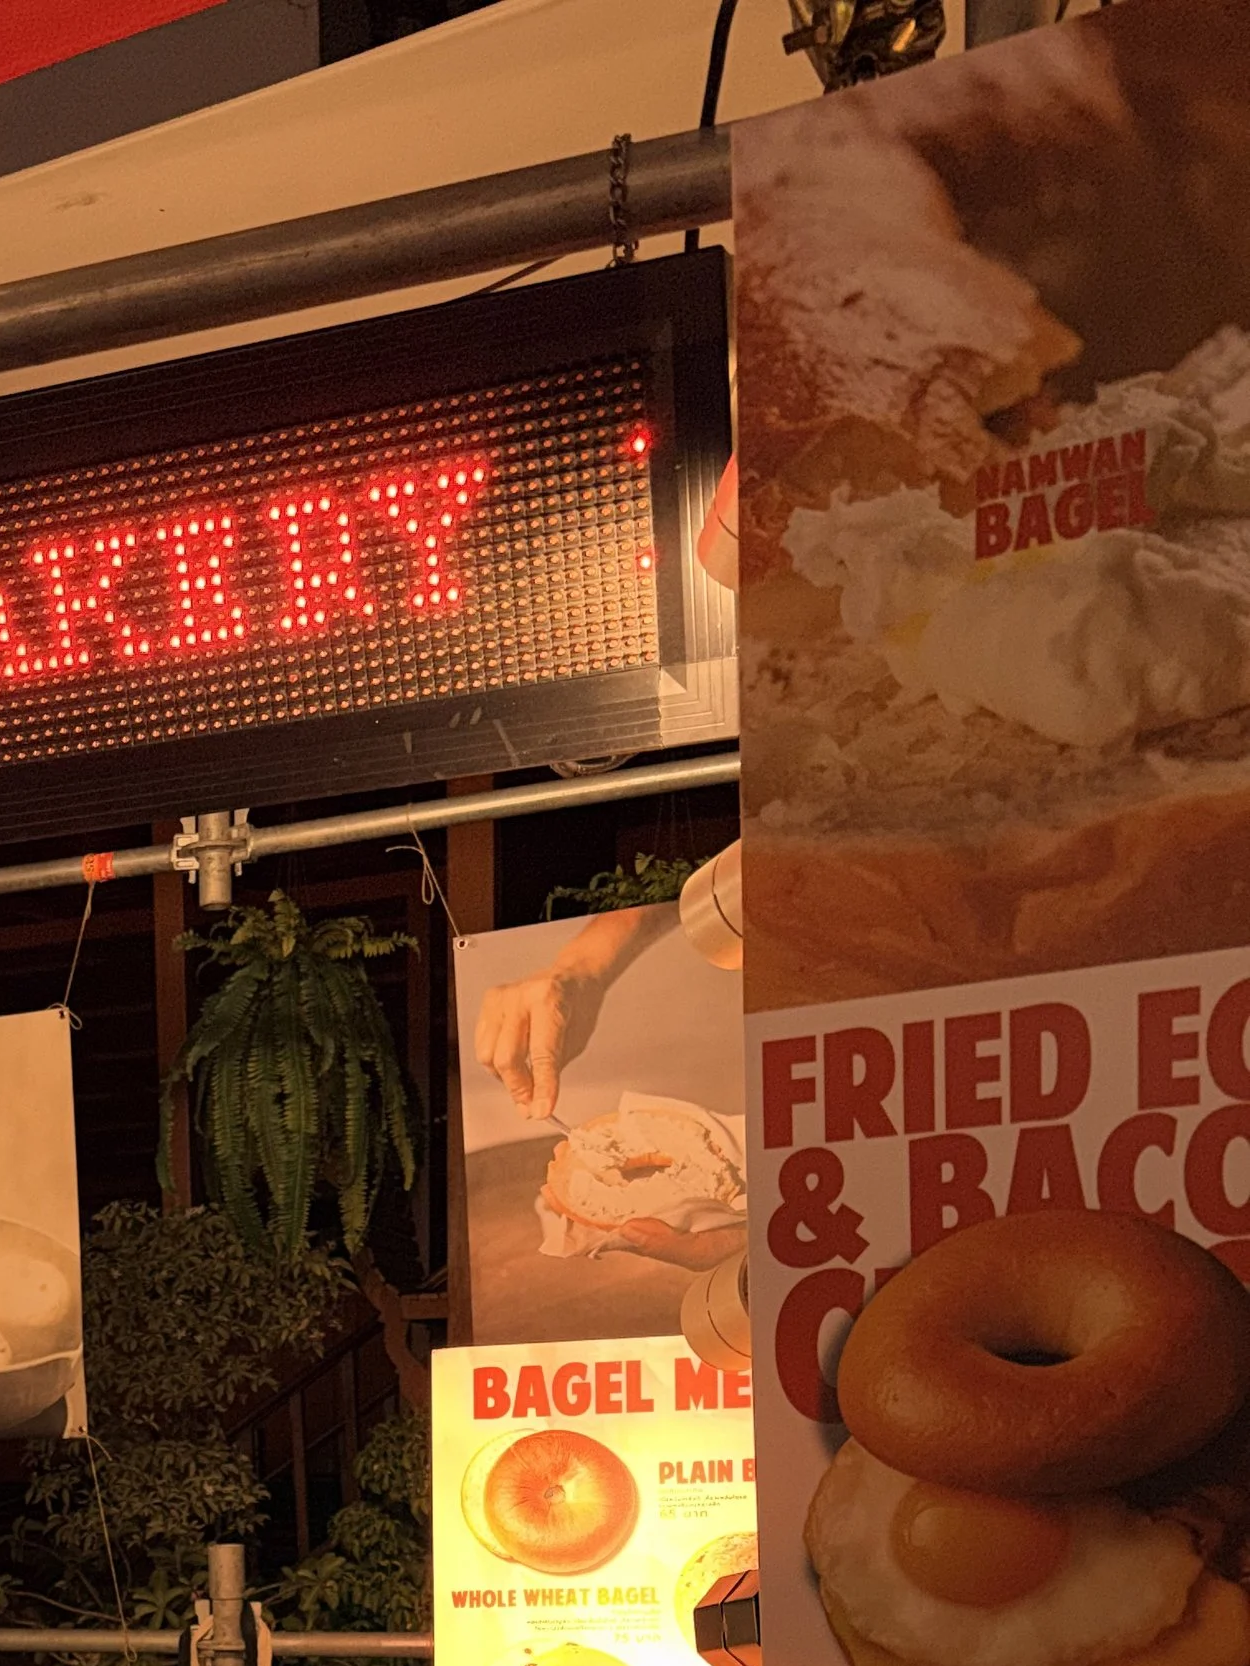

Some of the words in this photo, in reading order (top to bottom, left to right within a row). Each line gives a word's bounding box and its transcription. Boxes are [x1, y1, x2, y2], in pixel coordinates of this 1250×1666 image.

[975, 427, 1146, 501] NAMWAN
[975, 469, 1155, 561] BAGEL
[761, 1002, 1092, 1150] FRIED
[767, 1146, 870, 1268] &
[473, 1360, 654, 1420] BAGEL
[659, 1460, 733, 1484] PLAIN
[451, 1588, 517, 1609] WHOLE
[524, 1588, 590, 1607] WHEAT
[597, 1586, 660, 1605] BAGEL
